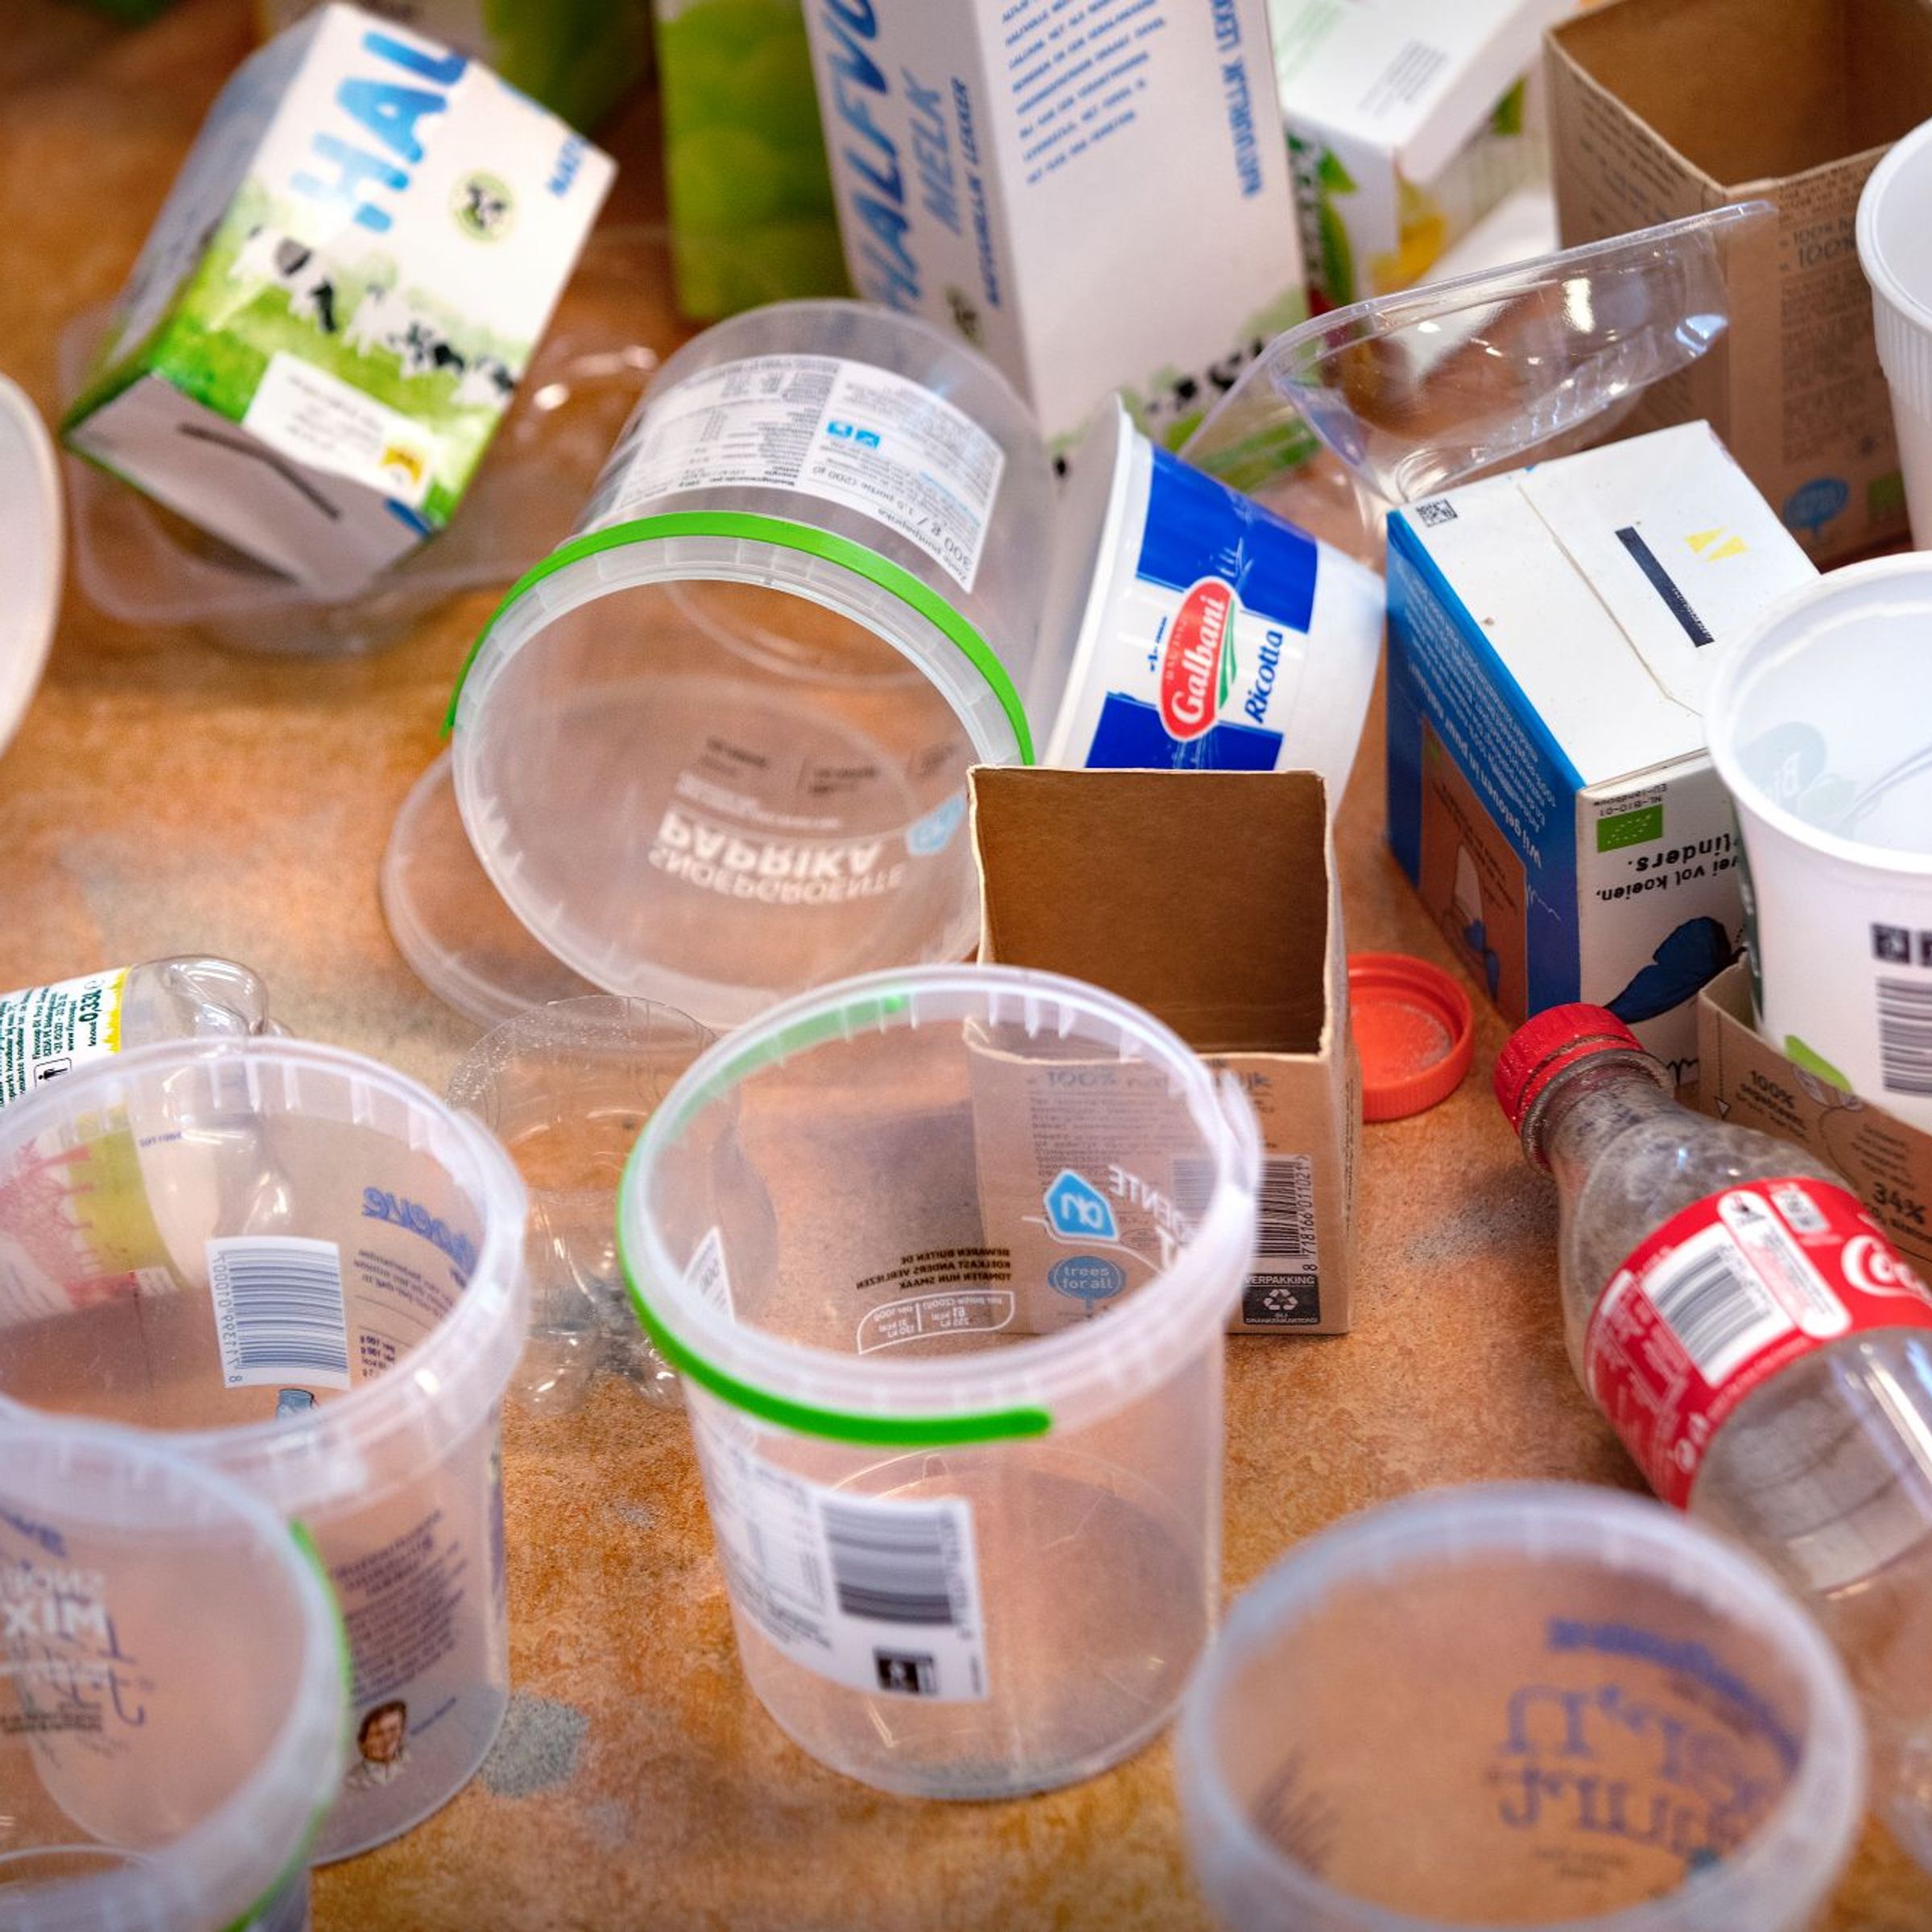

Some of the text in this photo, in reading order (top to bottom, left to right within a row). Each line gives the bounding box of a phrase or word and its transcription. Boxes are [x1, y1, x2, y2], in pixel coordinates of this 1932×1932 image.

[951, 76, 979, 166] LEKKER
[901, 64, 963, 237] MELK
[1170, 594, 1227, 726] Galbani
[1243, 628, 1284, 724] Ricotta
[1479, 769, 1522, 839] geloven
[1596, 875, 1668, 902] koeien,
[1675, 865, 1705, 886] vol
[1063, 1265, 1110, 1278] trees
[1245, 1274, 1315, 1286] VERPAKKING
[1302, 1263, 1319, 1272] 8
[1062, 1277, 1114, 1290] for all
